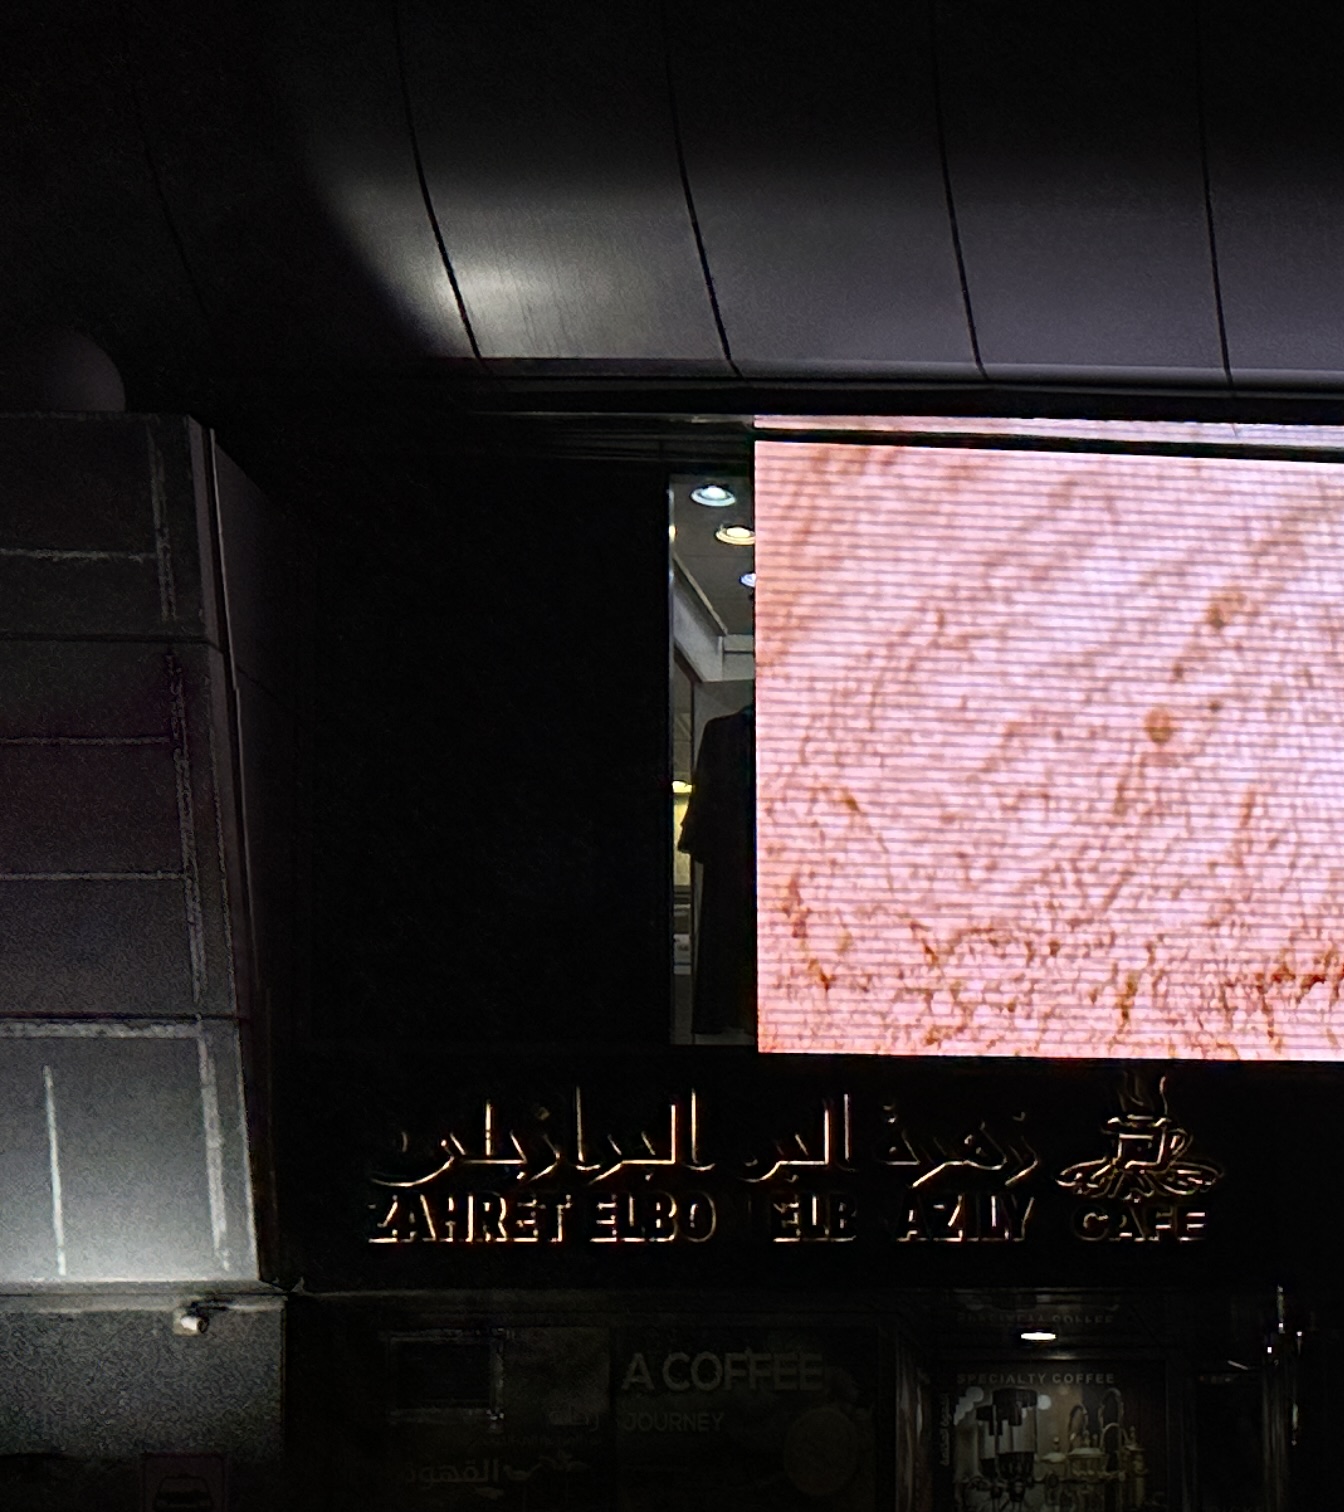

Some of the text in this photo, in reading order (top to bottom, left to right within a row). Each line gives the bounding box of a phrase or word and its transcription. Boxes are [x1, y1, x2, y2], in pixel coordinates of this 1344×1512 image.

[1073, 1204, 1208, 1243] CAFE
[620, 1349, 824, 1392] A COFFEE
[956, 1372, 1115, 1385] SPECIALTY COFFEE
[624, 1411, 725, 1432] JOURNEY
